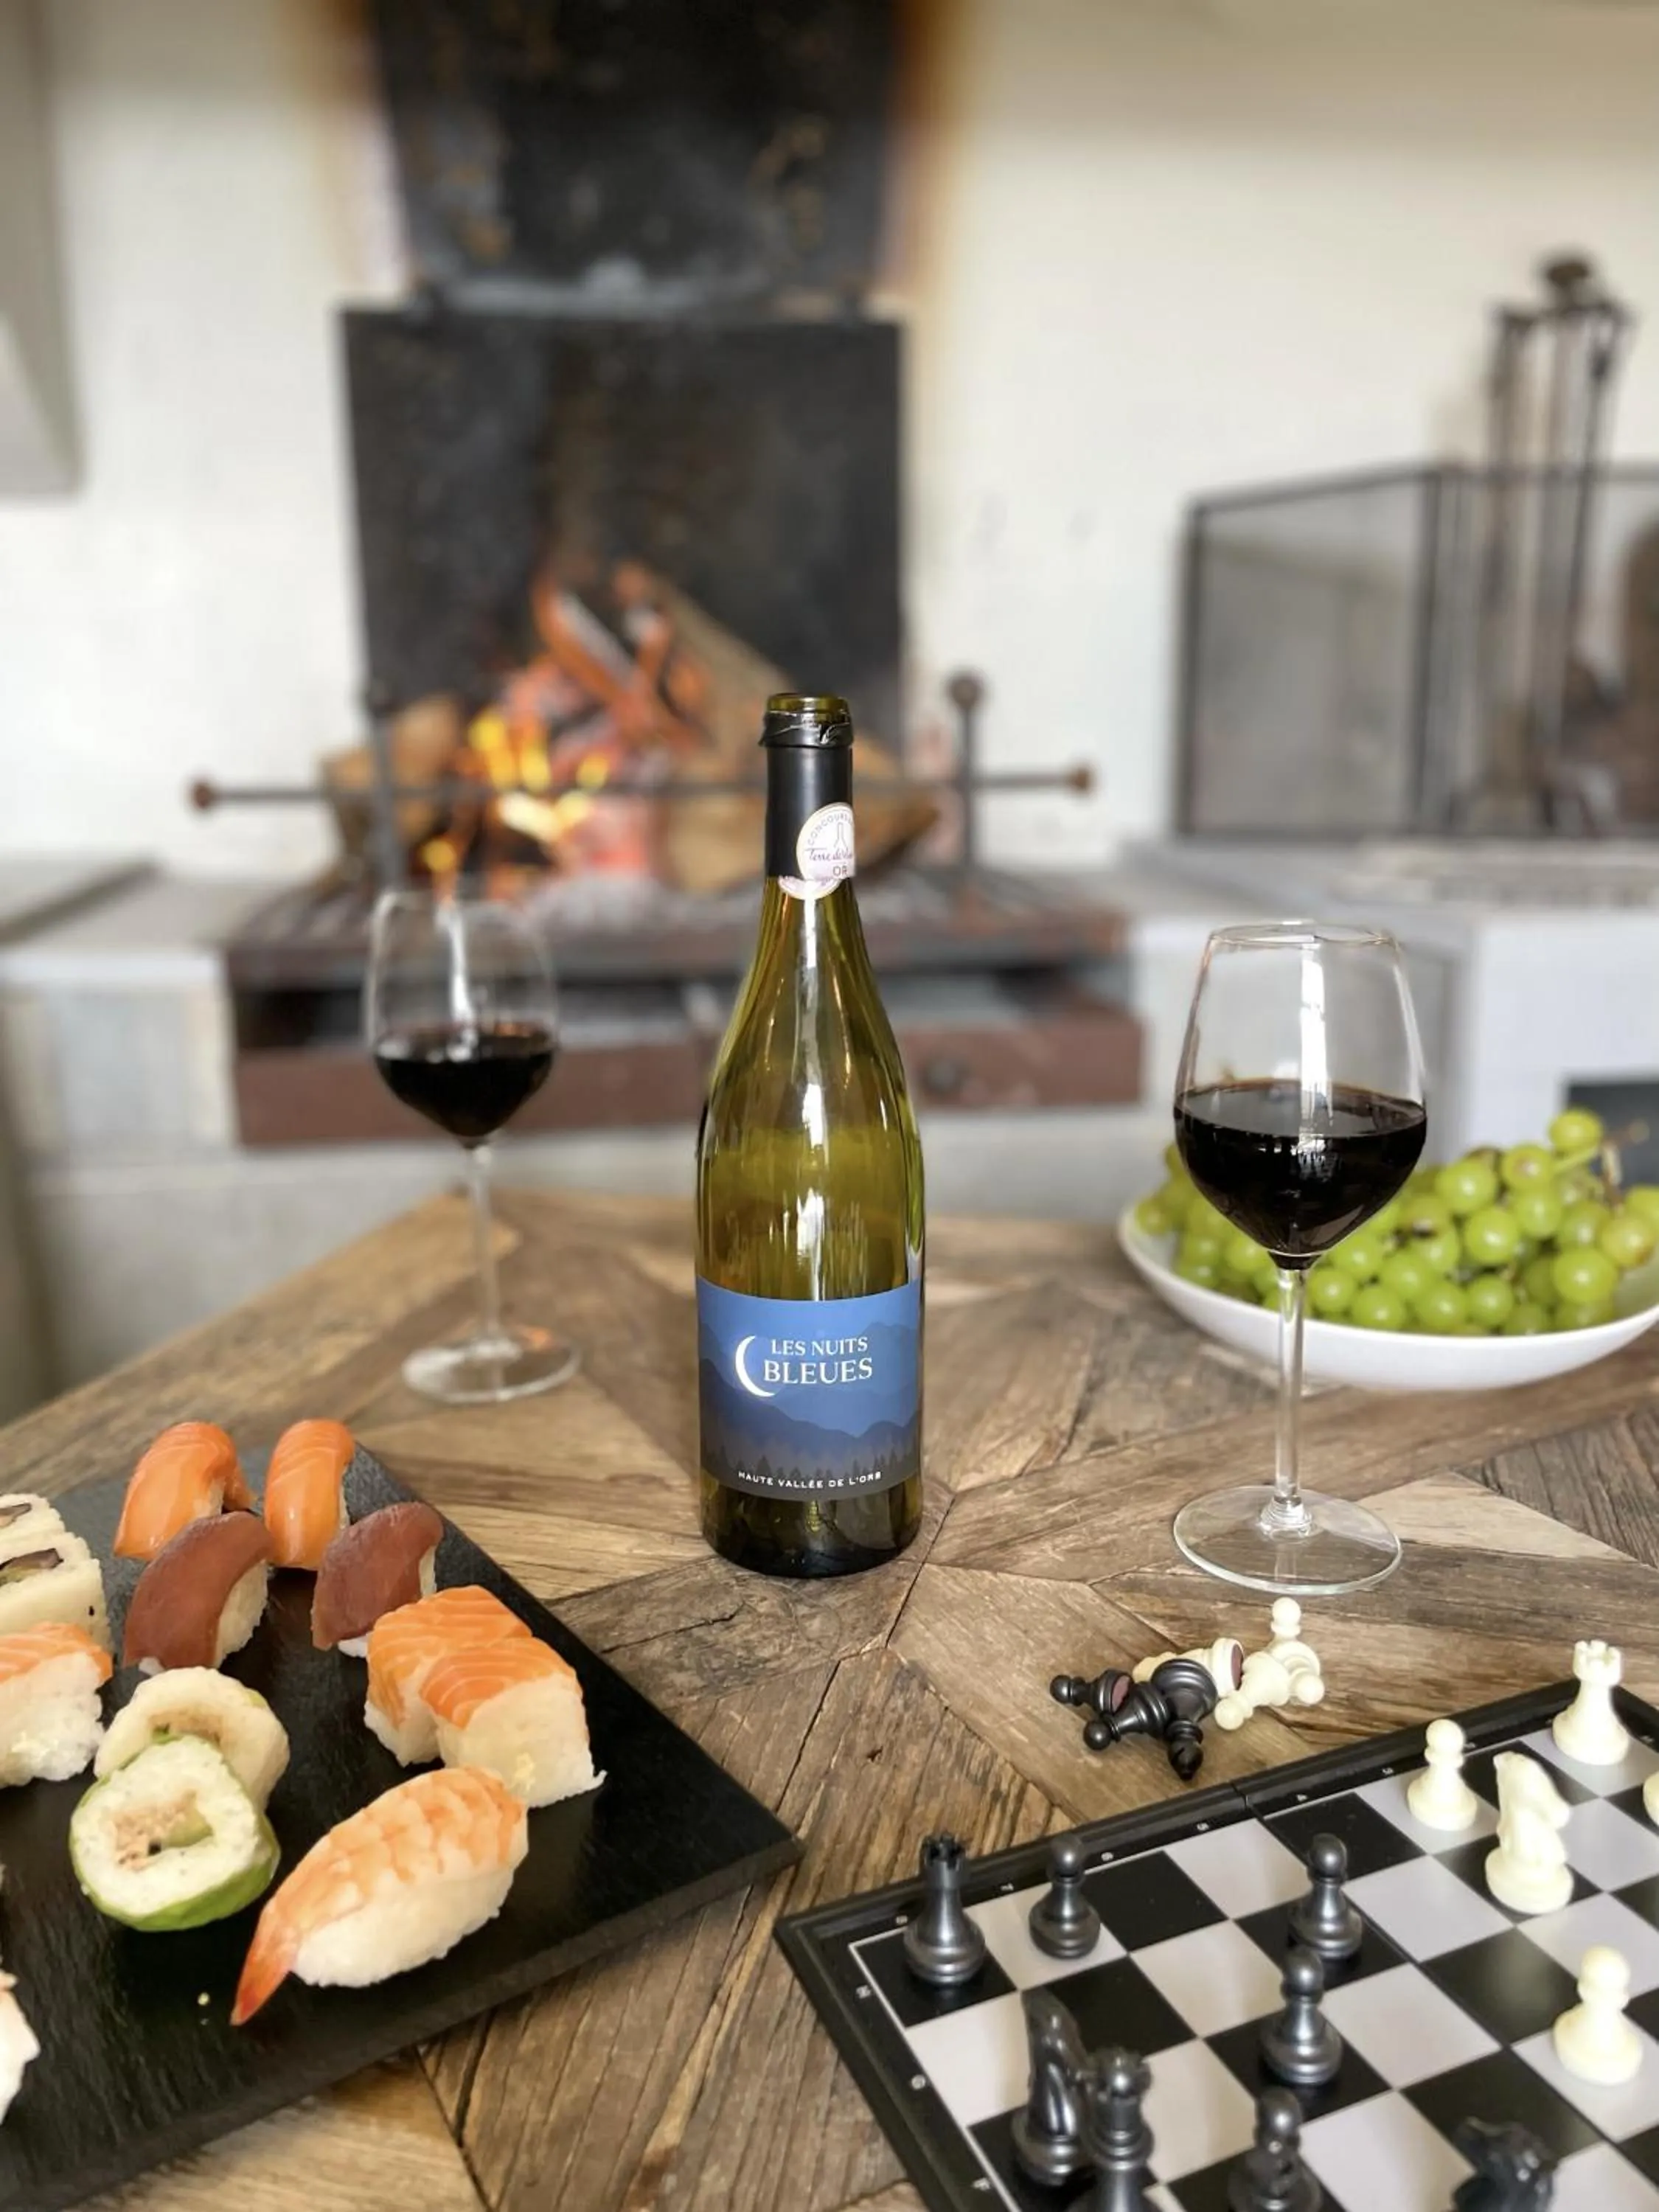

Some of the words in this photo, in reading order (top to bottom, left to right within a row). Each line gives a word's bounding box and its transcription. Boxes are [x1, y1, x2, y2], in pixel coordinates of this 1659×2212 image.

[832, 866, 847, 877] OR
[772, 1339, 806, 1356] LES
[812, 1336, 869, 1356] NUITS
[764, 1357, 872, 1385] BLEUES
[738, 1471, 773, 1486] HAUTE
[778, 1478, 824, 1489] VALLÉE
[829, 1478, 844, 1488] DE
[849, 1470, 882, 1485] L'ORB
